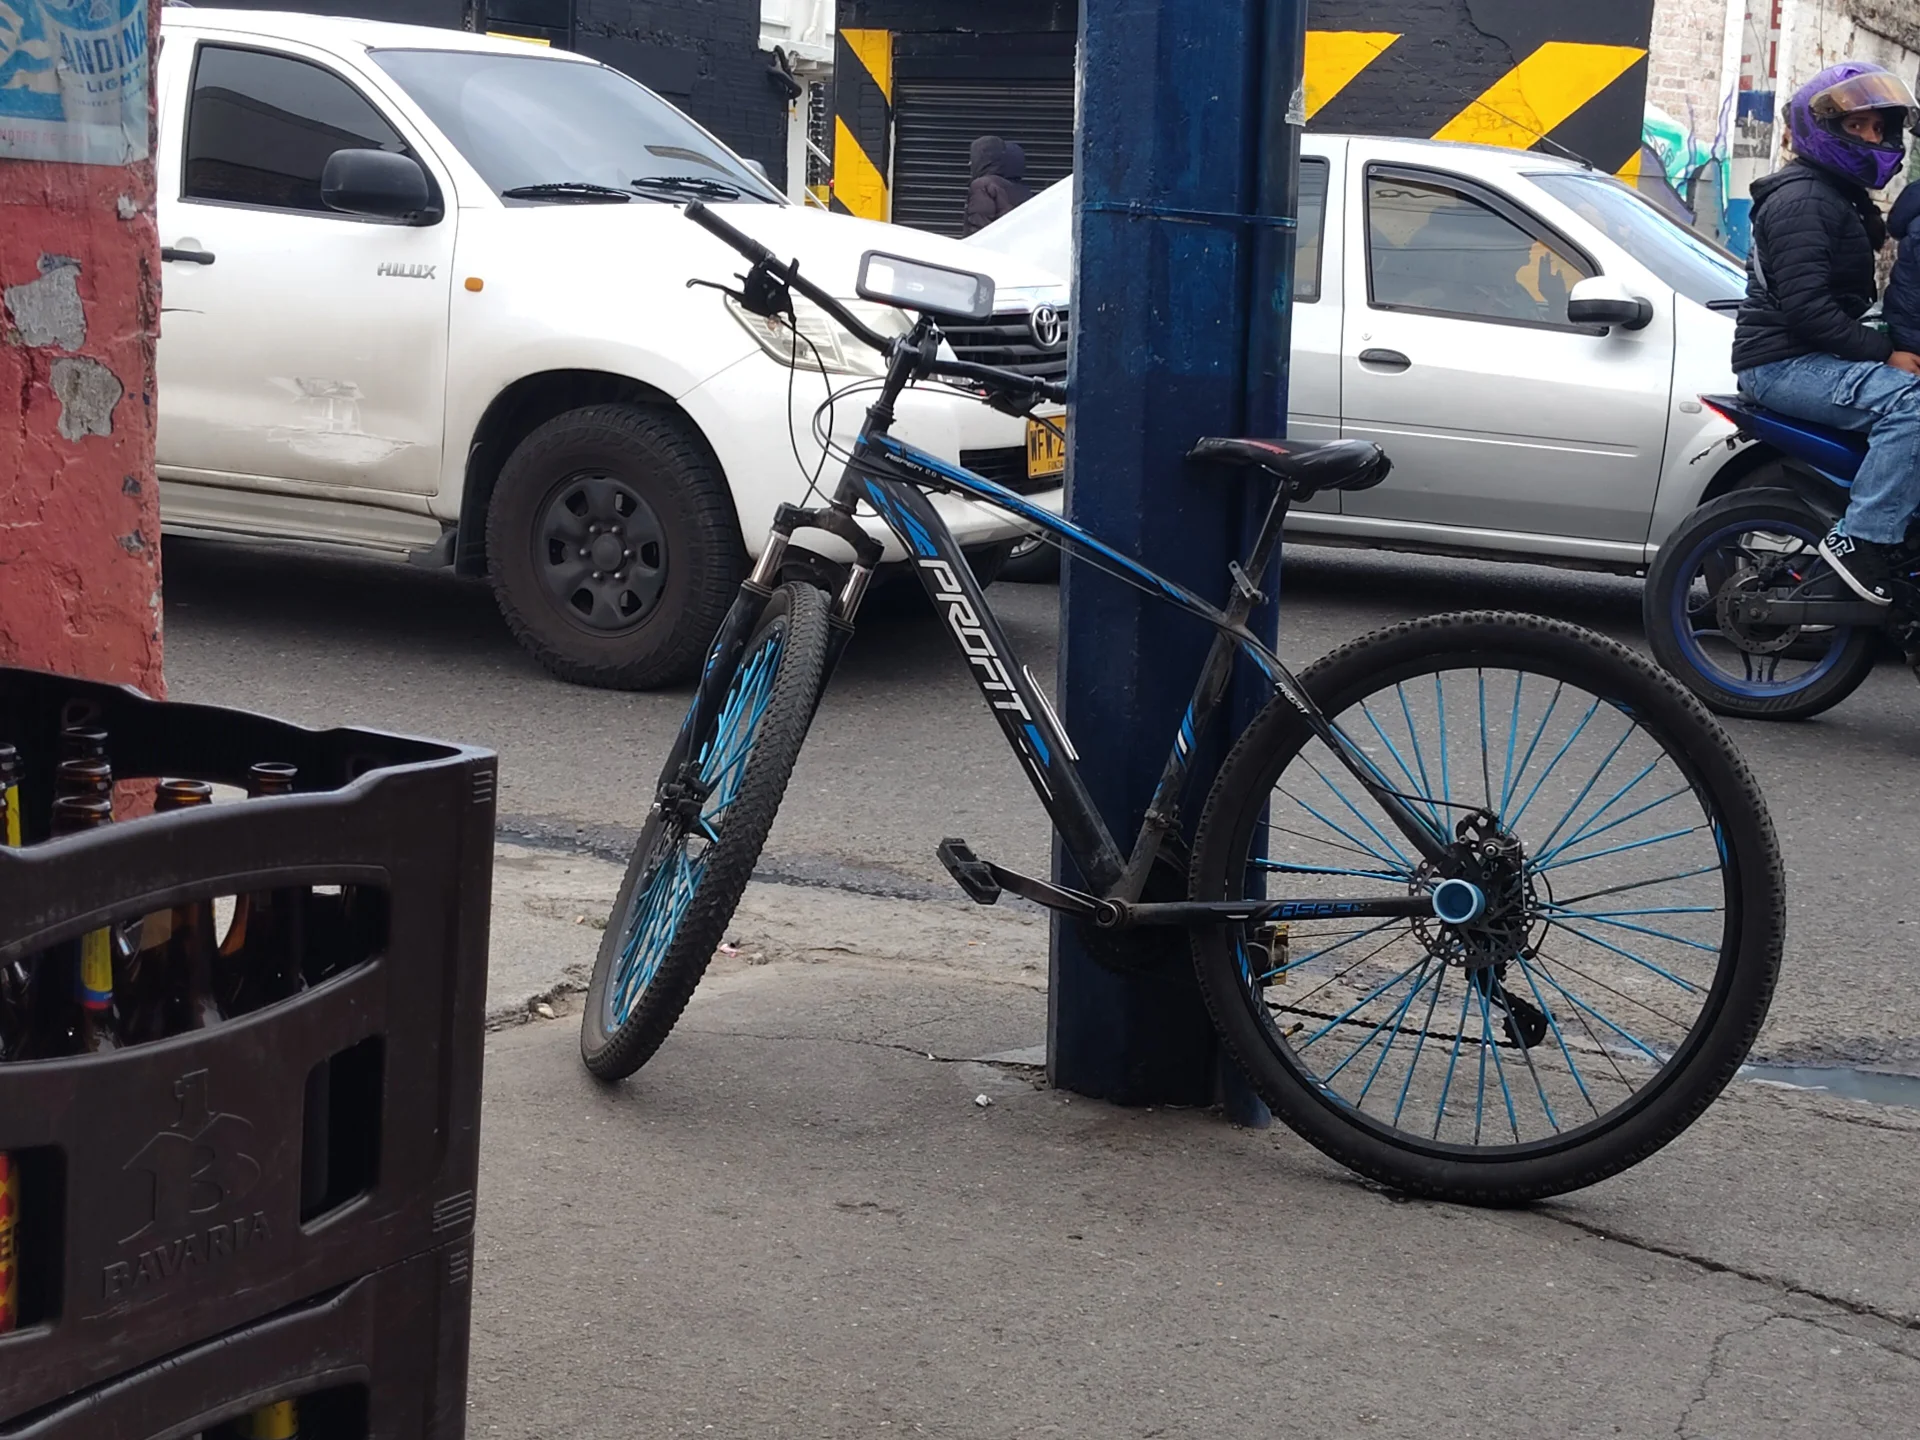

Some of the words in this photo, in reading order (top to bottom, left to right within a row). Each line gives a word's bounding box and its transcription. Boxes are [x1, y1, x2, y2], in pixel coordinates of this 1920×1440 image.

[59, 10, 148, 75] ANDINA
[86, 64, 142, 93] LIGHT
[377, 262, 437, 280] HILUX
[918, 559, 1032, 721] PROFIT
[1275, 682, 1310, 714] PROFIT
[103, 1210, 273, 1299] BAVARIA
